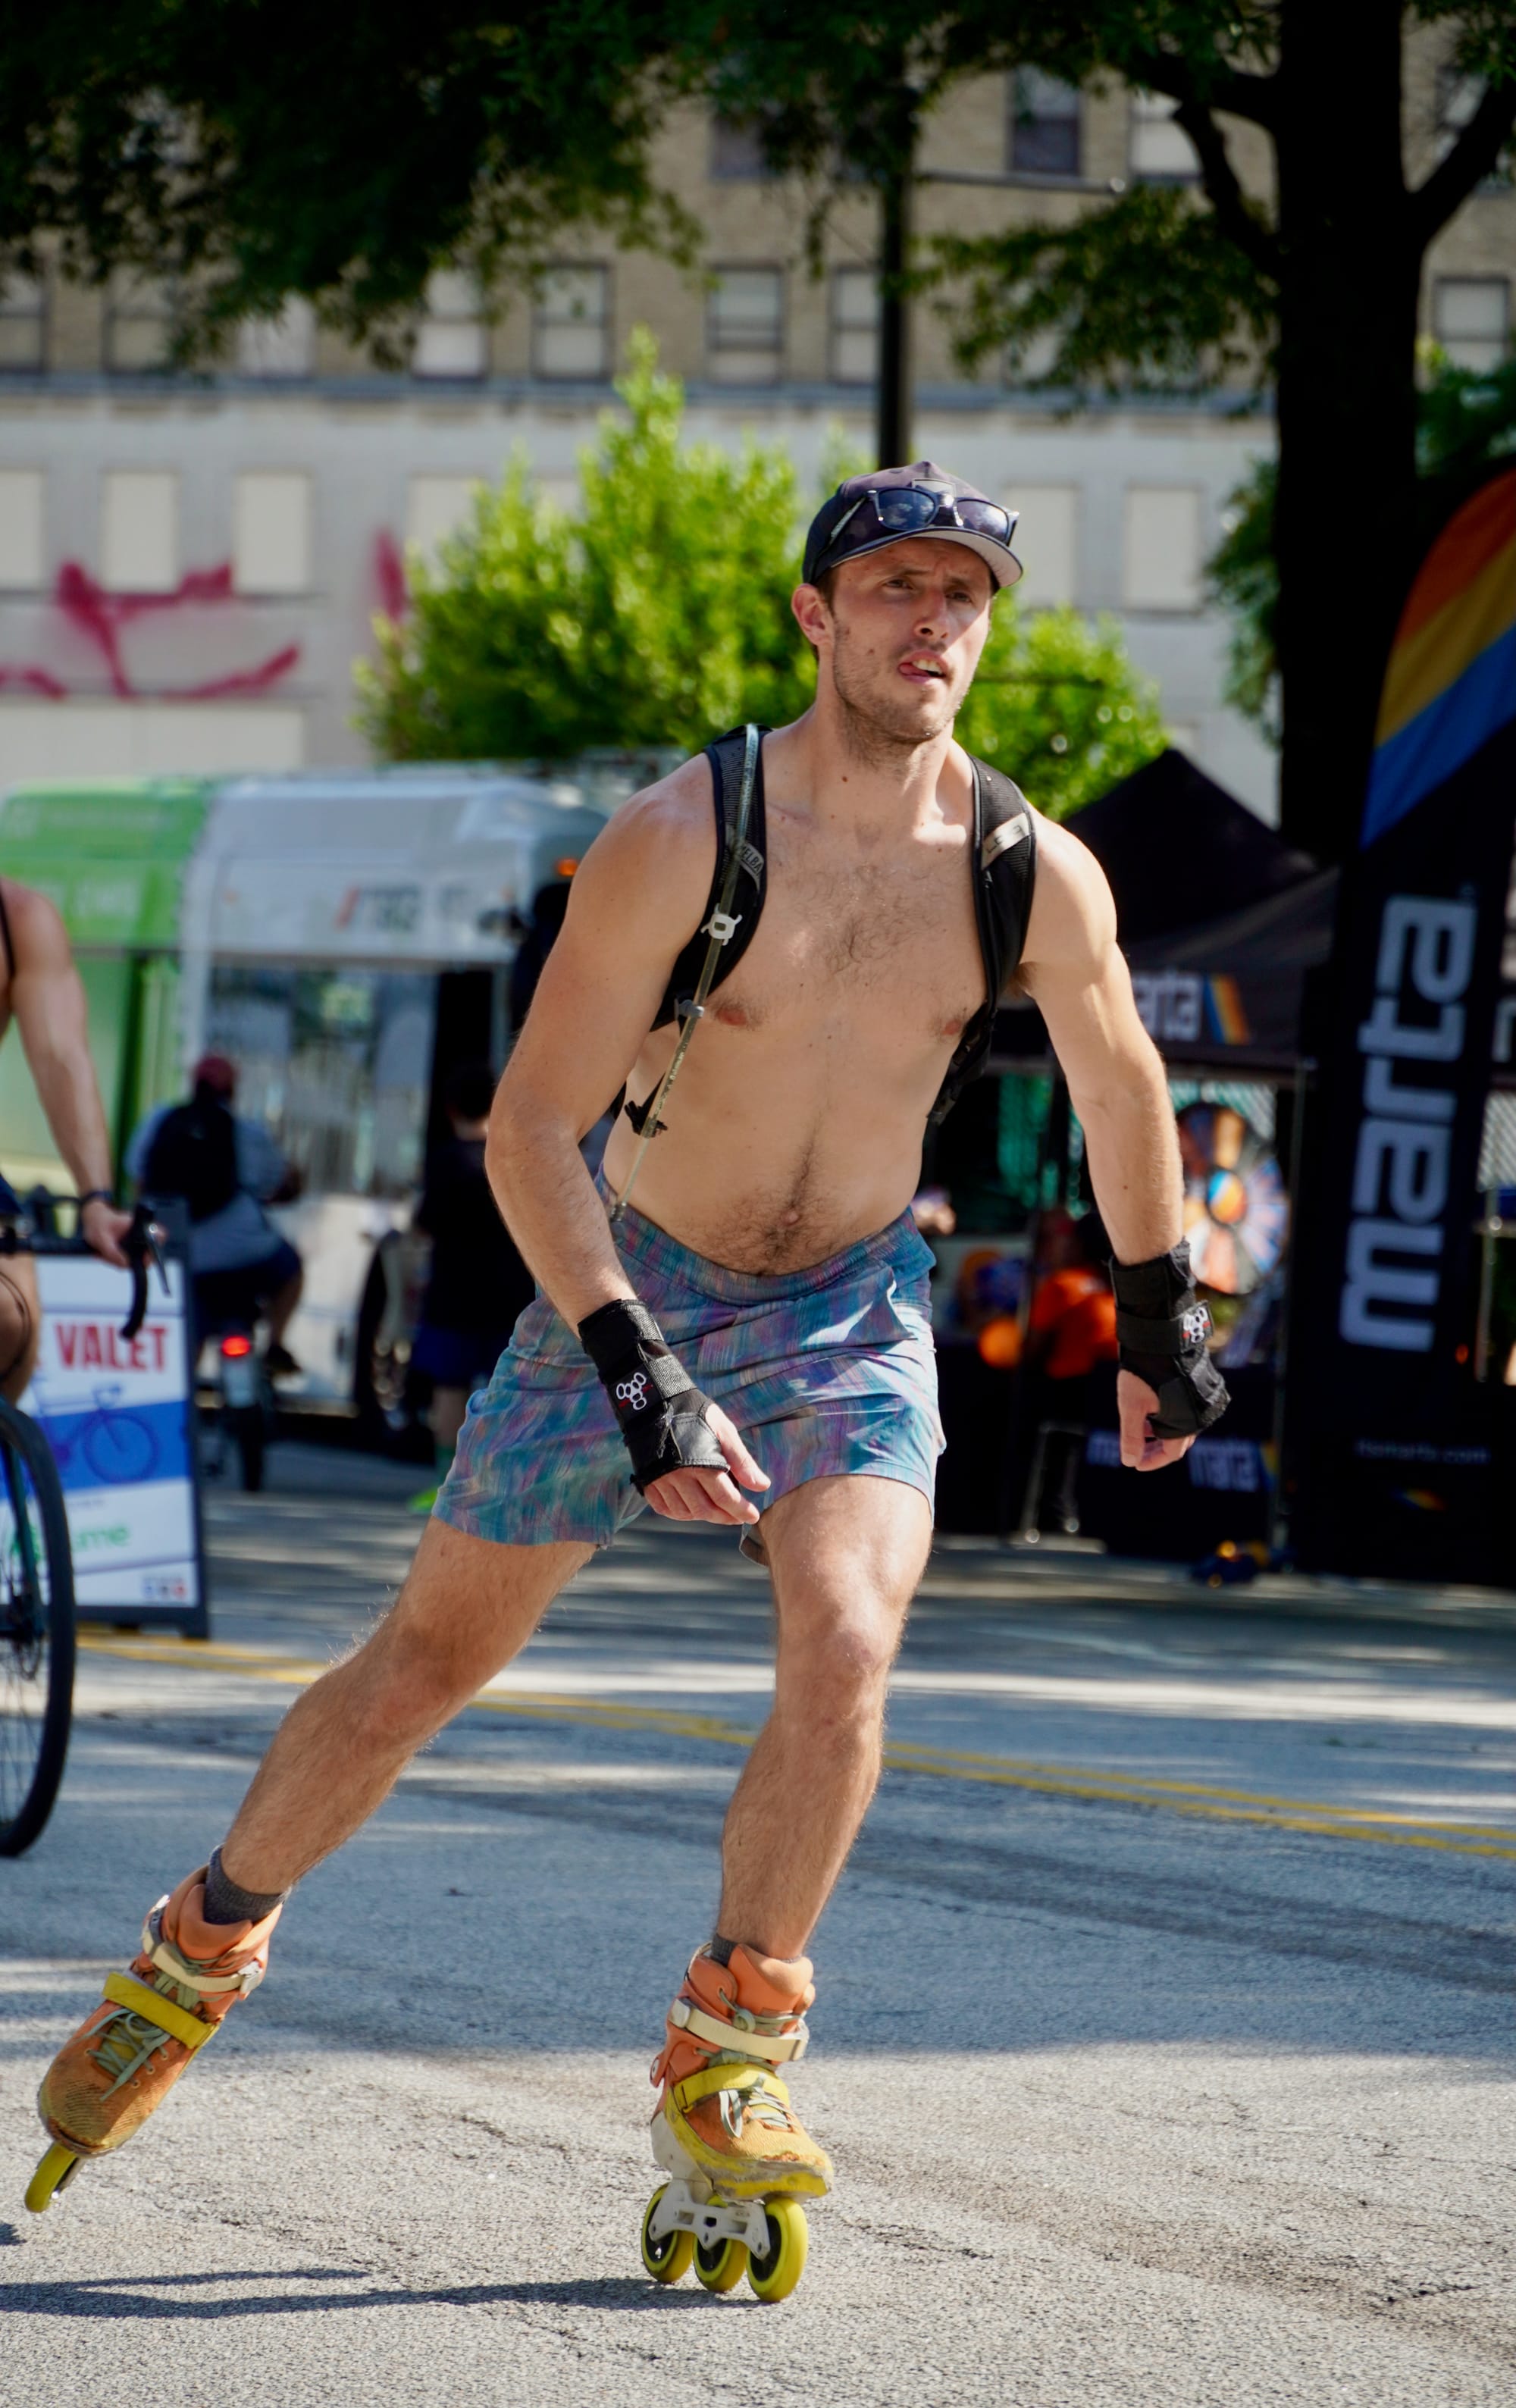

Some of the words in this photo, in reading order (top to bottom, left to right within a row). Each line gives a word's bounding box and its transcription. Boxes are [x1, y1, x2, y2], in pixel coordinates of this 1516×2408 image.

[1132, 968, 1201, 1041] arta
[1340, 895, 1477, 1351] marta
[55, 1323, 168, 1373] VALET
